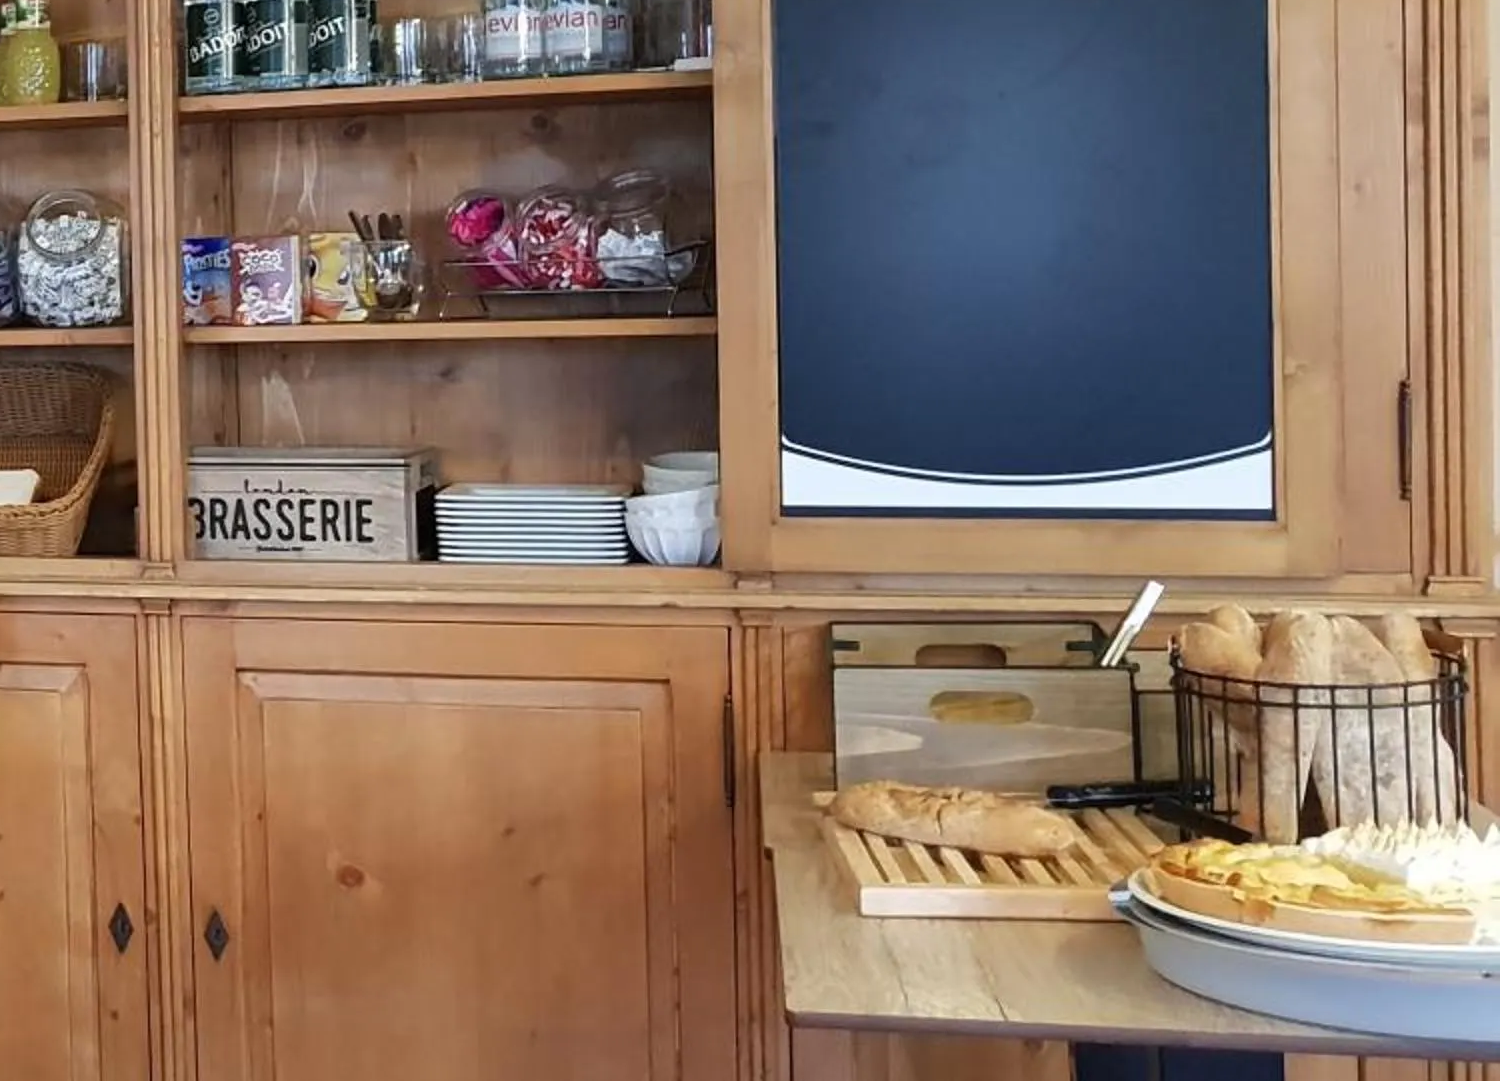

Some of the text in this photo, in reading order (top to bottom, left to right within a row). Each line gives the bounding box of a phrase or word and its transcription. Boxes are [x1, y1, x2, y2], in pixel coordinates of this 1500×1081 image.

[248, 22, 289, 52] DOIT
[309, 17, 344, 48] DOIT
[188, 498, 374, 543] BRASSERIE
